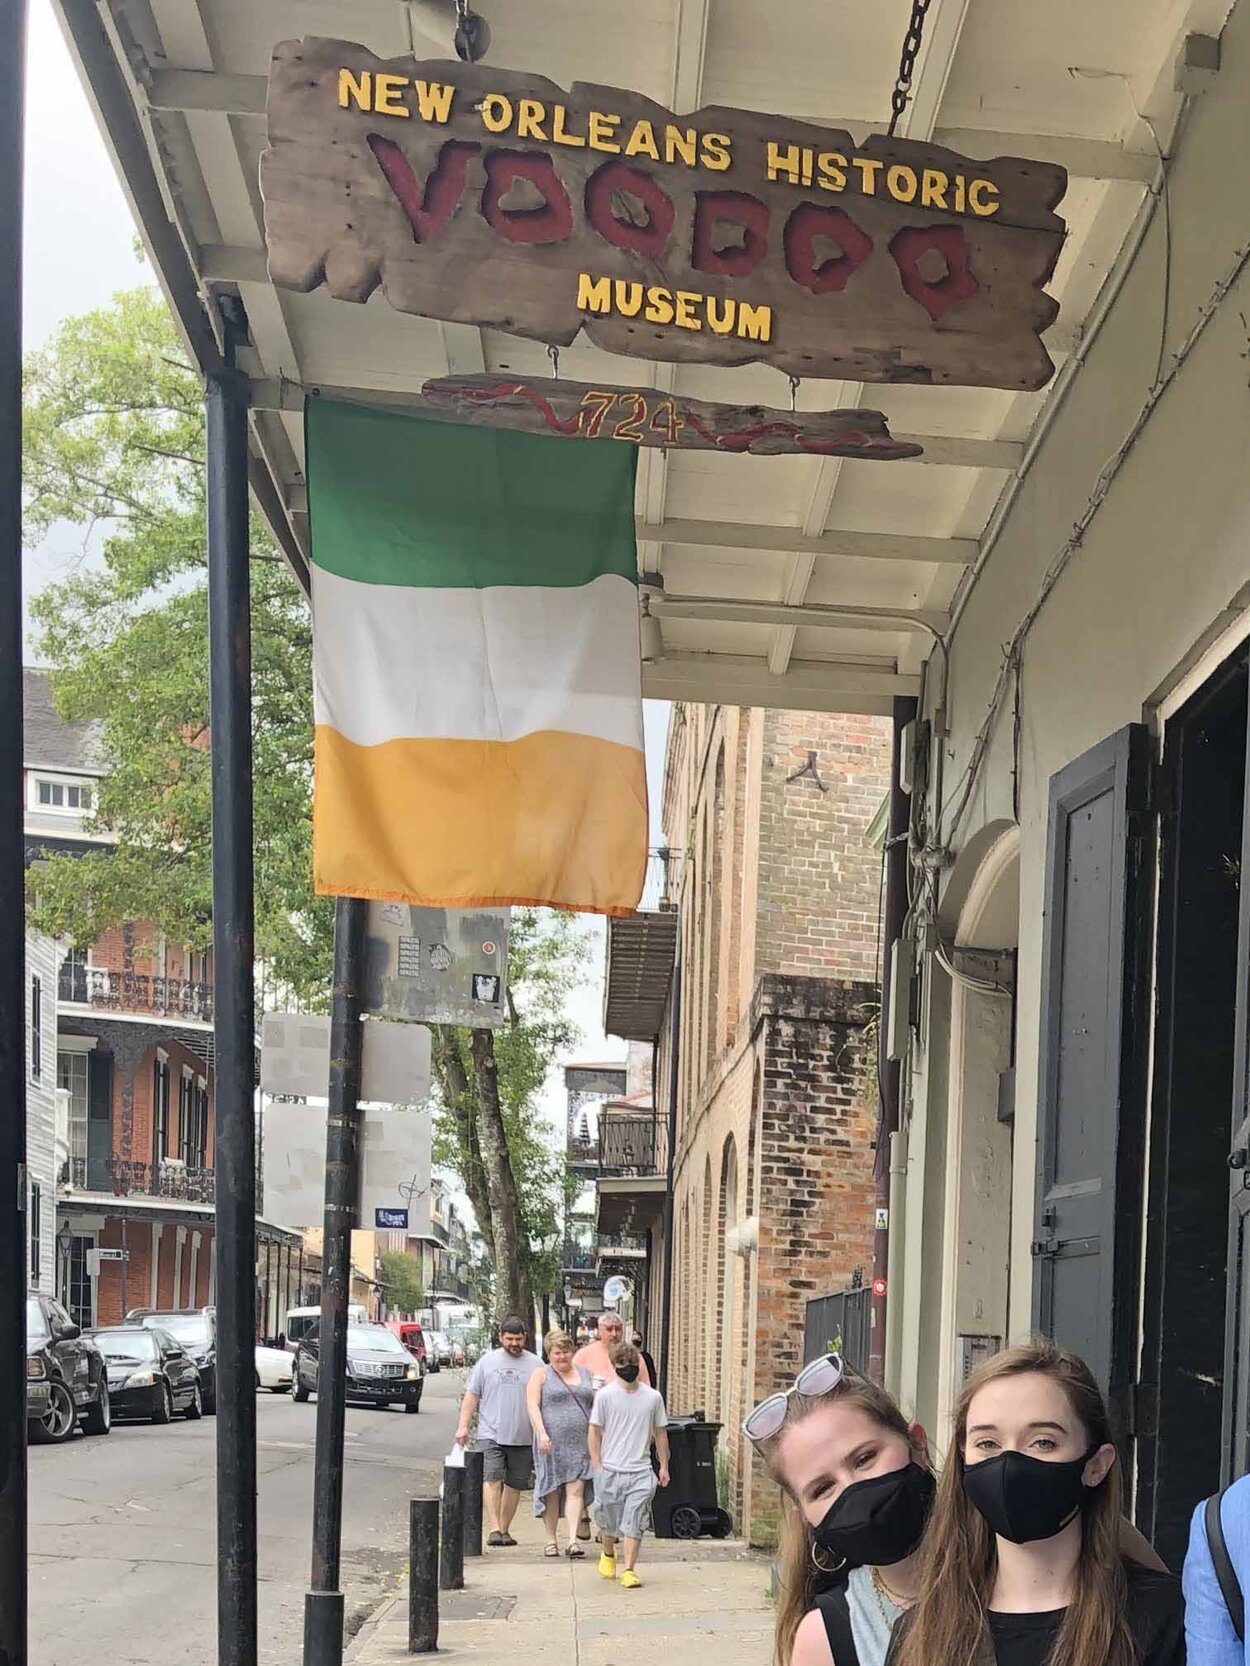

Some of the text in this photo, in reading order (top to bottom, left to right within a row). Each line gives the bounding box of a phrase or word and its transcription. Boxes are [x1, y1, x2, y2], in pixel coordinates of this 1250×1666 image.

[339, 67, 1001, 217] NEW ORLEANS HISTORIC
[366, 132, 980, 320] VOODOO
[576, 272, 773, 342] MUSEUM
[577, 390, 684, 447] 724
